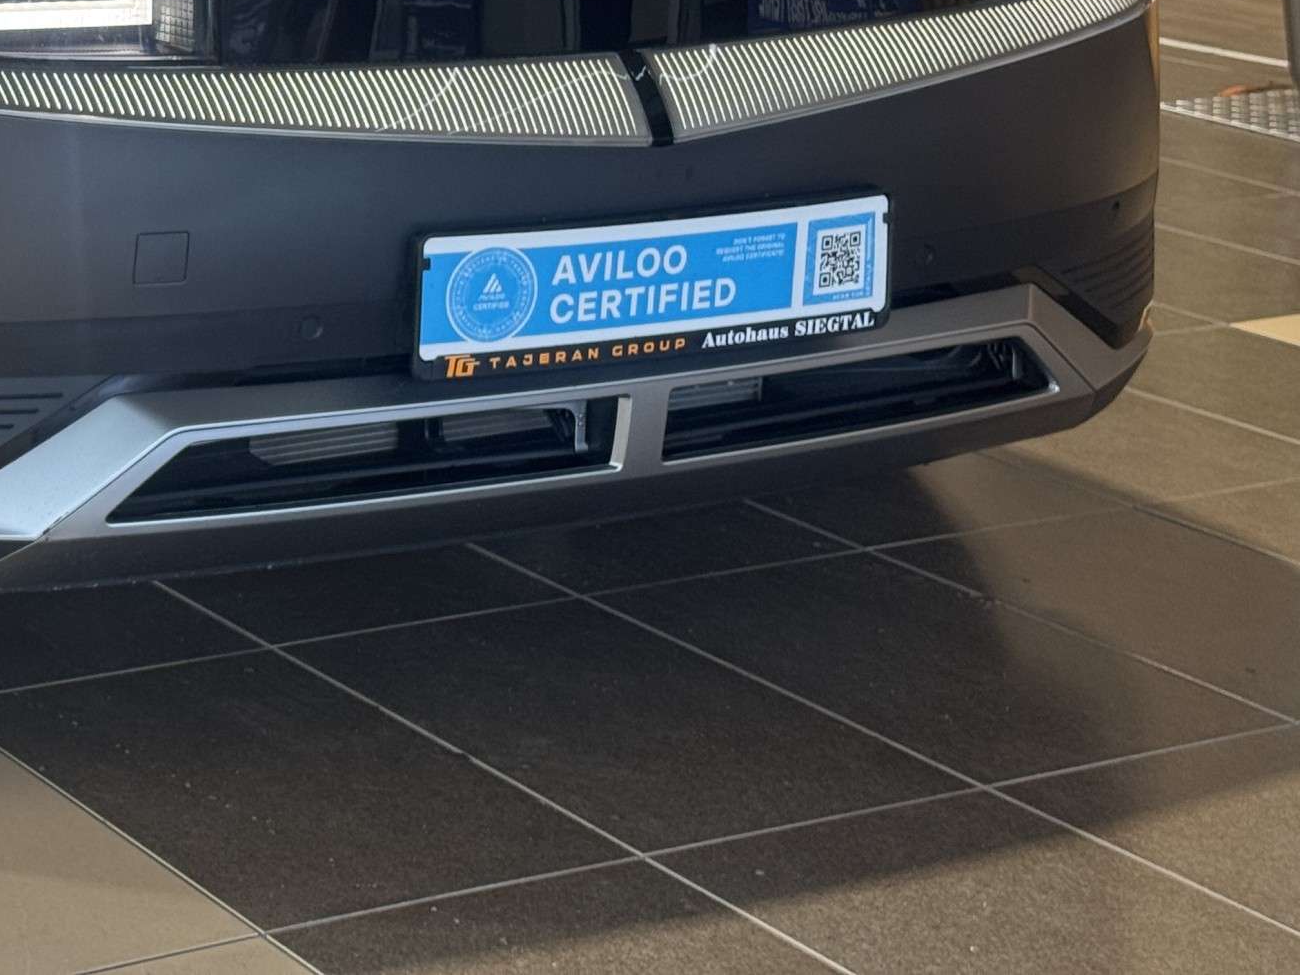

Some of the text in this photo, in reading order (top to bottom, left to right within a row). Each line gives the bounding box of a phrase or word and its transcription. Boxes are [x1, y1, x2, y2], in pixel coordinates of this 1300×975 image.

[552, 244, 687, 286] AVILOO
[550, 277, 737, 324] CERTIFIED
[611, 337, 686, 358] GROUP
[701, 311, 875, 349] Autohaus SIEGTAL
